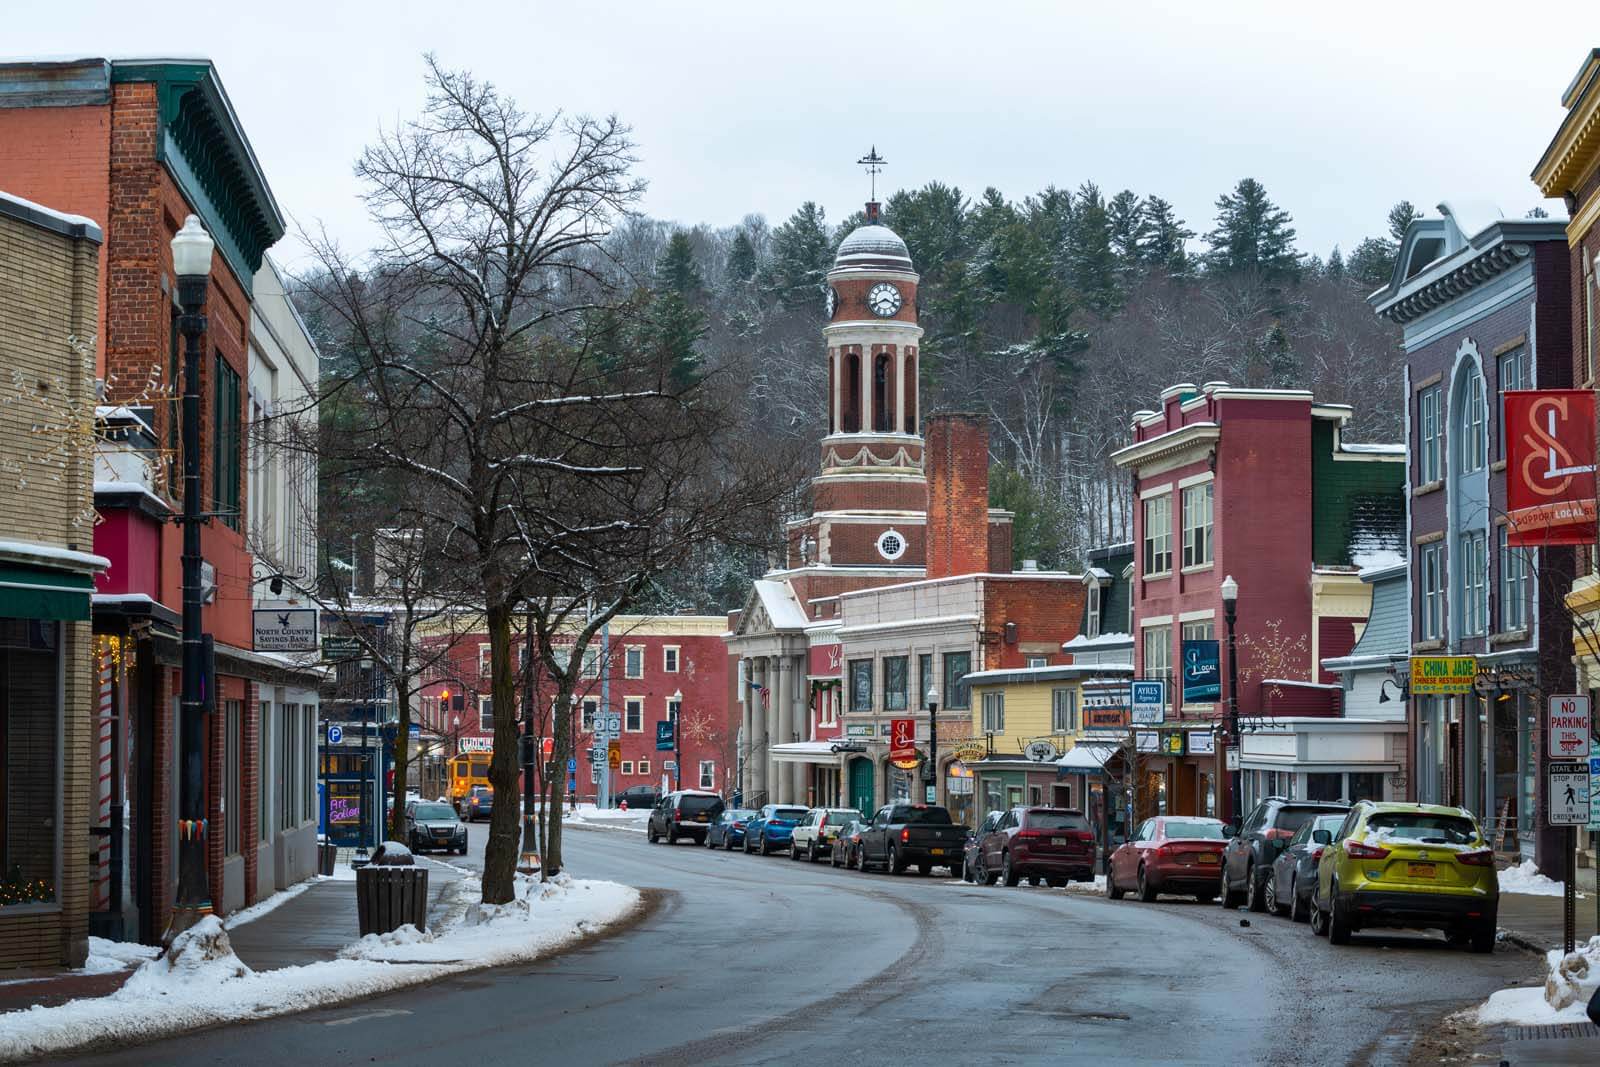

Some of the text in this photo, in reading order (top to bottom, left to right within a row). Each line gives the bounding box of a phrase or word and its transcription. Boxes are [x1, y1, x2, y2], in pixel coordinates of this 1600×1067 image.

[1424, 660, 1448, 676] CHINA
[1453, 660, 1473, 676] JADE
[1137, 687, 1158, 695] AYRES
[1561, 702, 1576, 713] NO
[596, 721, 617, 729] 3 3
[1551, 716, 1588, 728] PARKING
[331, 728, 340, 741] P
[594, 750, 604, 759] 86
[330, 798, 347, 811] Art
